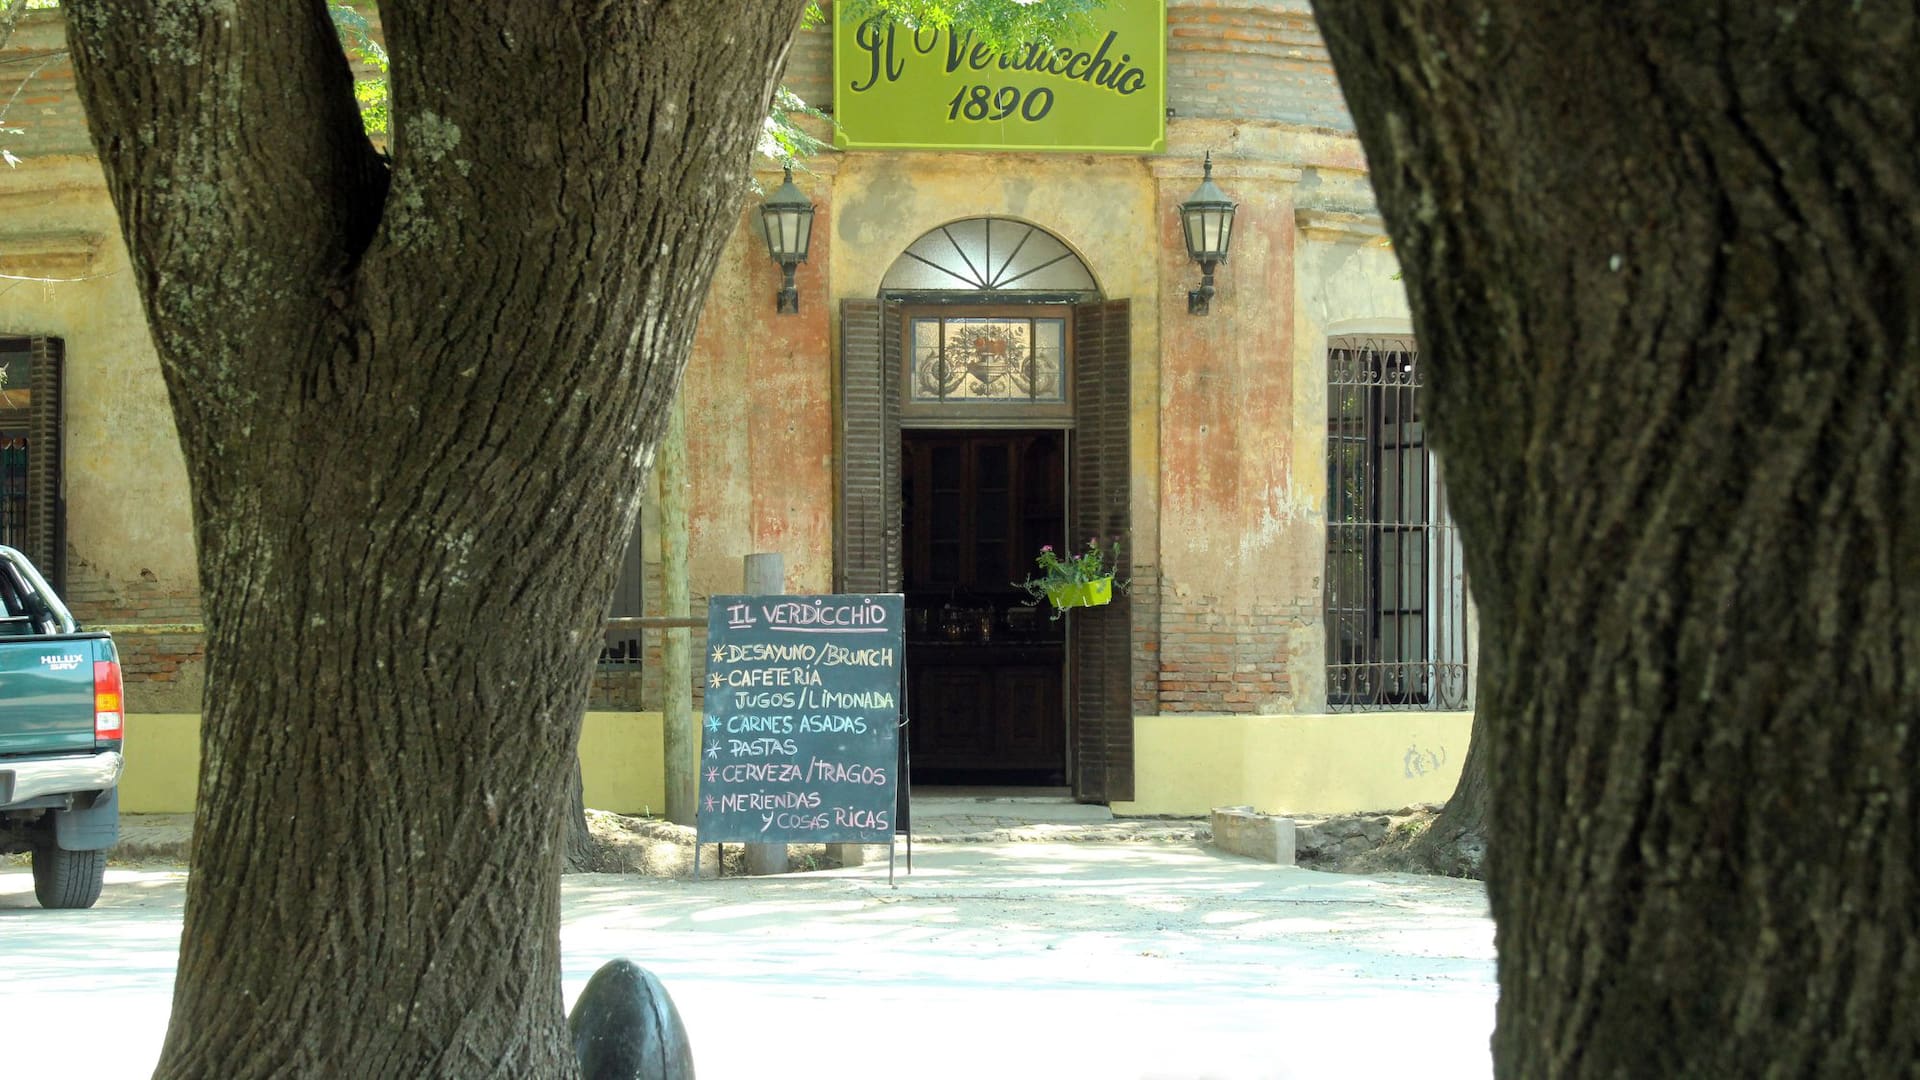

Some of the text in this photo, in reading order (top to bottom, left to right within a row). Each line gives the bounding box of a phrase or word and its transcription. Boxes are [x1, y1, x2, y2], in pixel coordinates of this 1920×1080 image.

[850, 10, 905, 92] Il
[948, 85, 1055, 122] 1890
[727, 603, 757, 625] IL
[40, 654, 83, 664] HILUX
[726, 714, 868, 734] CARNES ASADAS
[728, 737, 798, 756] PASTAS
[776, 812, 830, 831] COSAS
